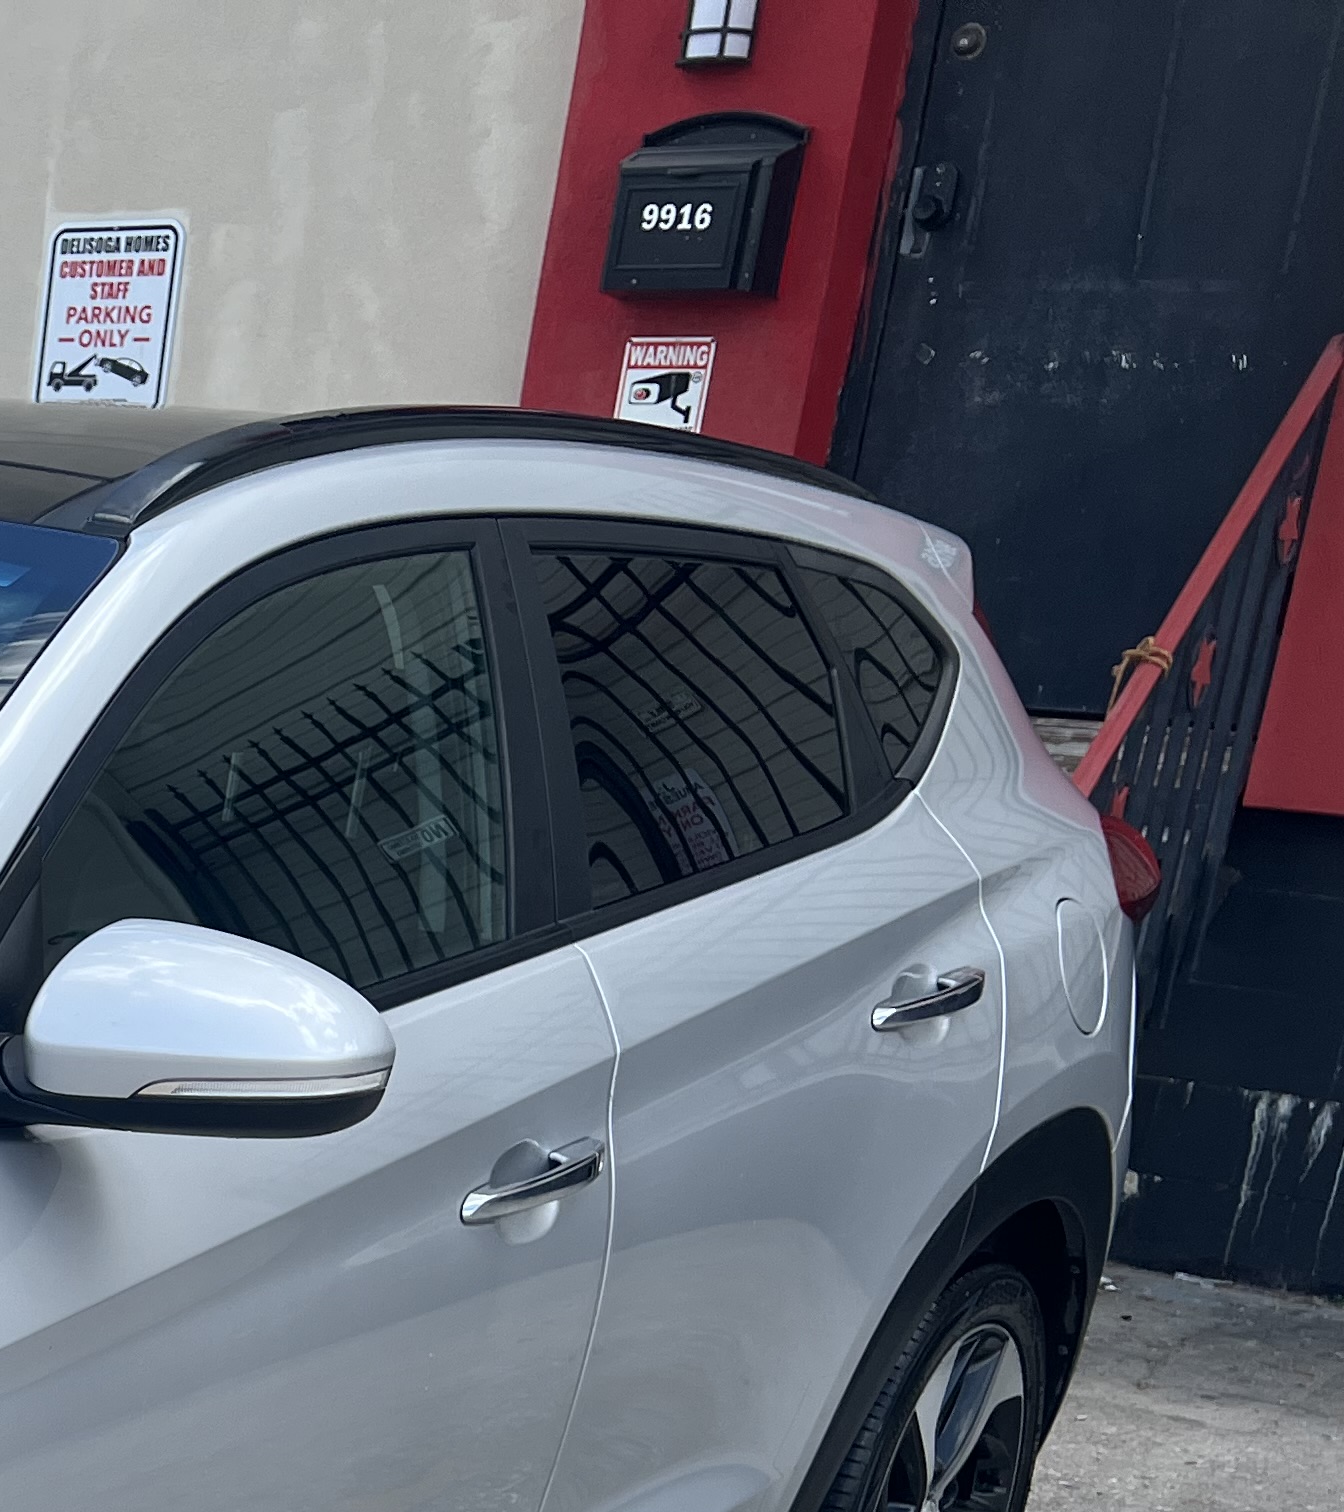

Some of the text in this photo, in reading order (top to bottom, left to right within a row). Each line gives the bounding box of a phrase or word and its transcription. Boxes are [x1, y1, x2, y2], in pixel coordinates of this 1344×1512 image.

[641, 203, 713, 231] 9916
[60, 235, 171, 255] DELISOGA HOMES
[59, 258, 166, 278] CUSTOMER AND
[90, 281, 131, 300] STAFF
[65, 305, 152, 325] PARKING
[78, 329, 130, 348] ONLY
[629, 344, 709, 368] WARNING
